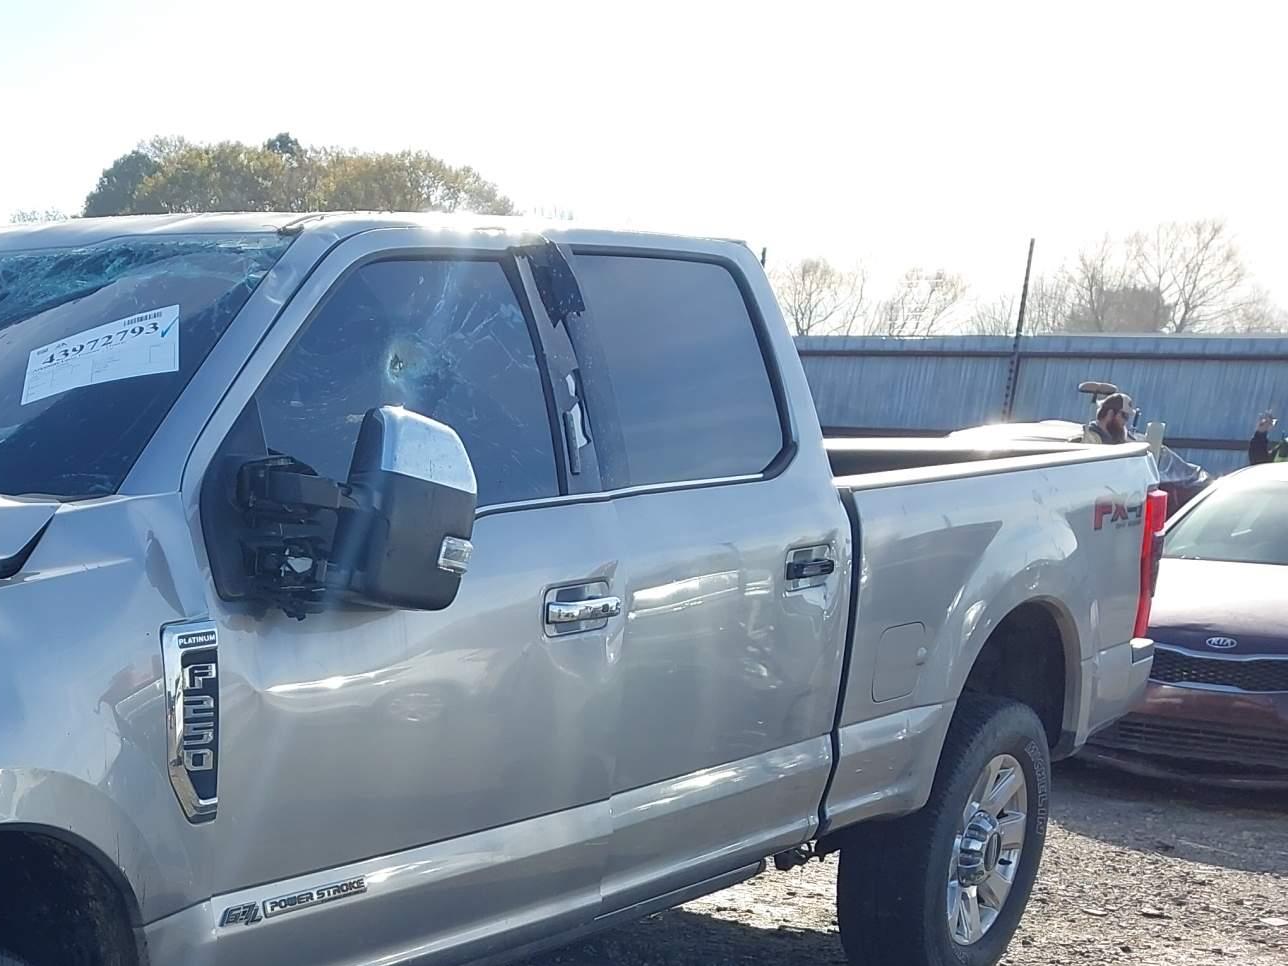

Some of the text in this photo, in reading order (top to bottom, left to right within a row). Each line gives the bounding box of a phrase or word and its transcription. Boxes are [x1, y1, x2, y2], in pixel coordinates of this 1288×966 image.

[41, 321, 159, 366] 43972793
[178, 631, 216, 646] PLATINUM
[1209, 637, 1235, 648] KIA
[183, 664, 217, 772] F250
[268, 891, 315, 912] POWER
[315, 877, 366, 900] STROKE
